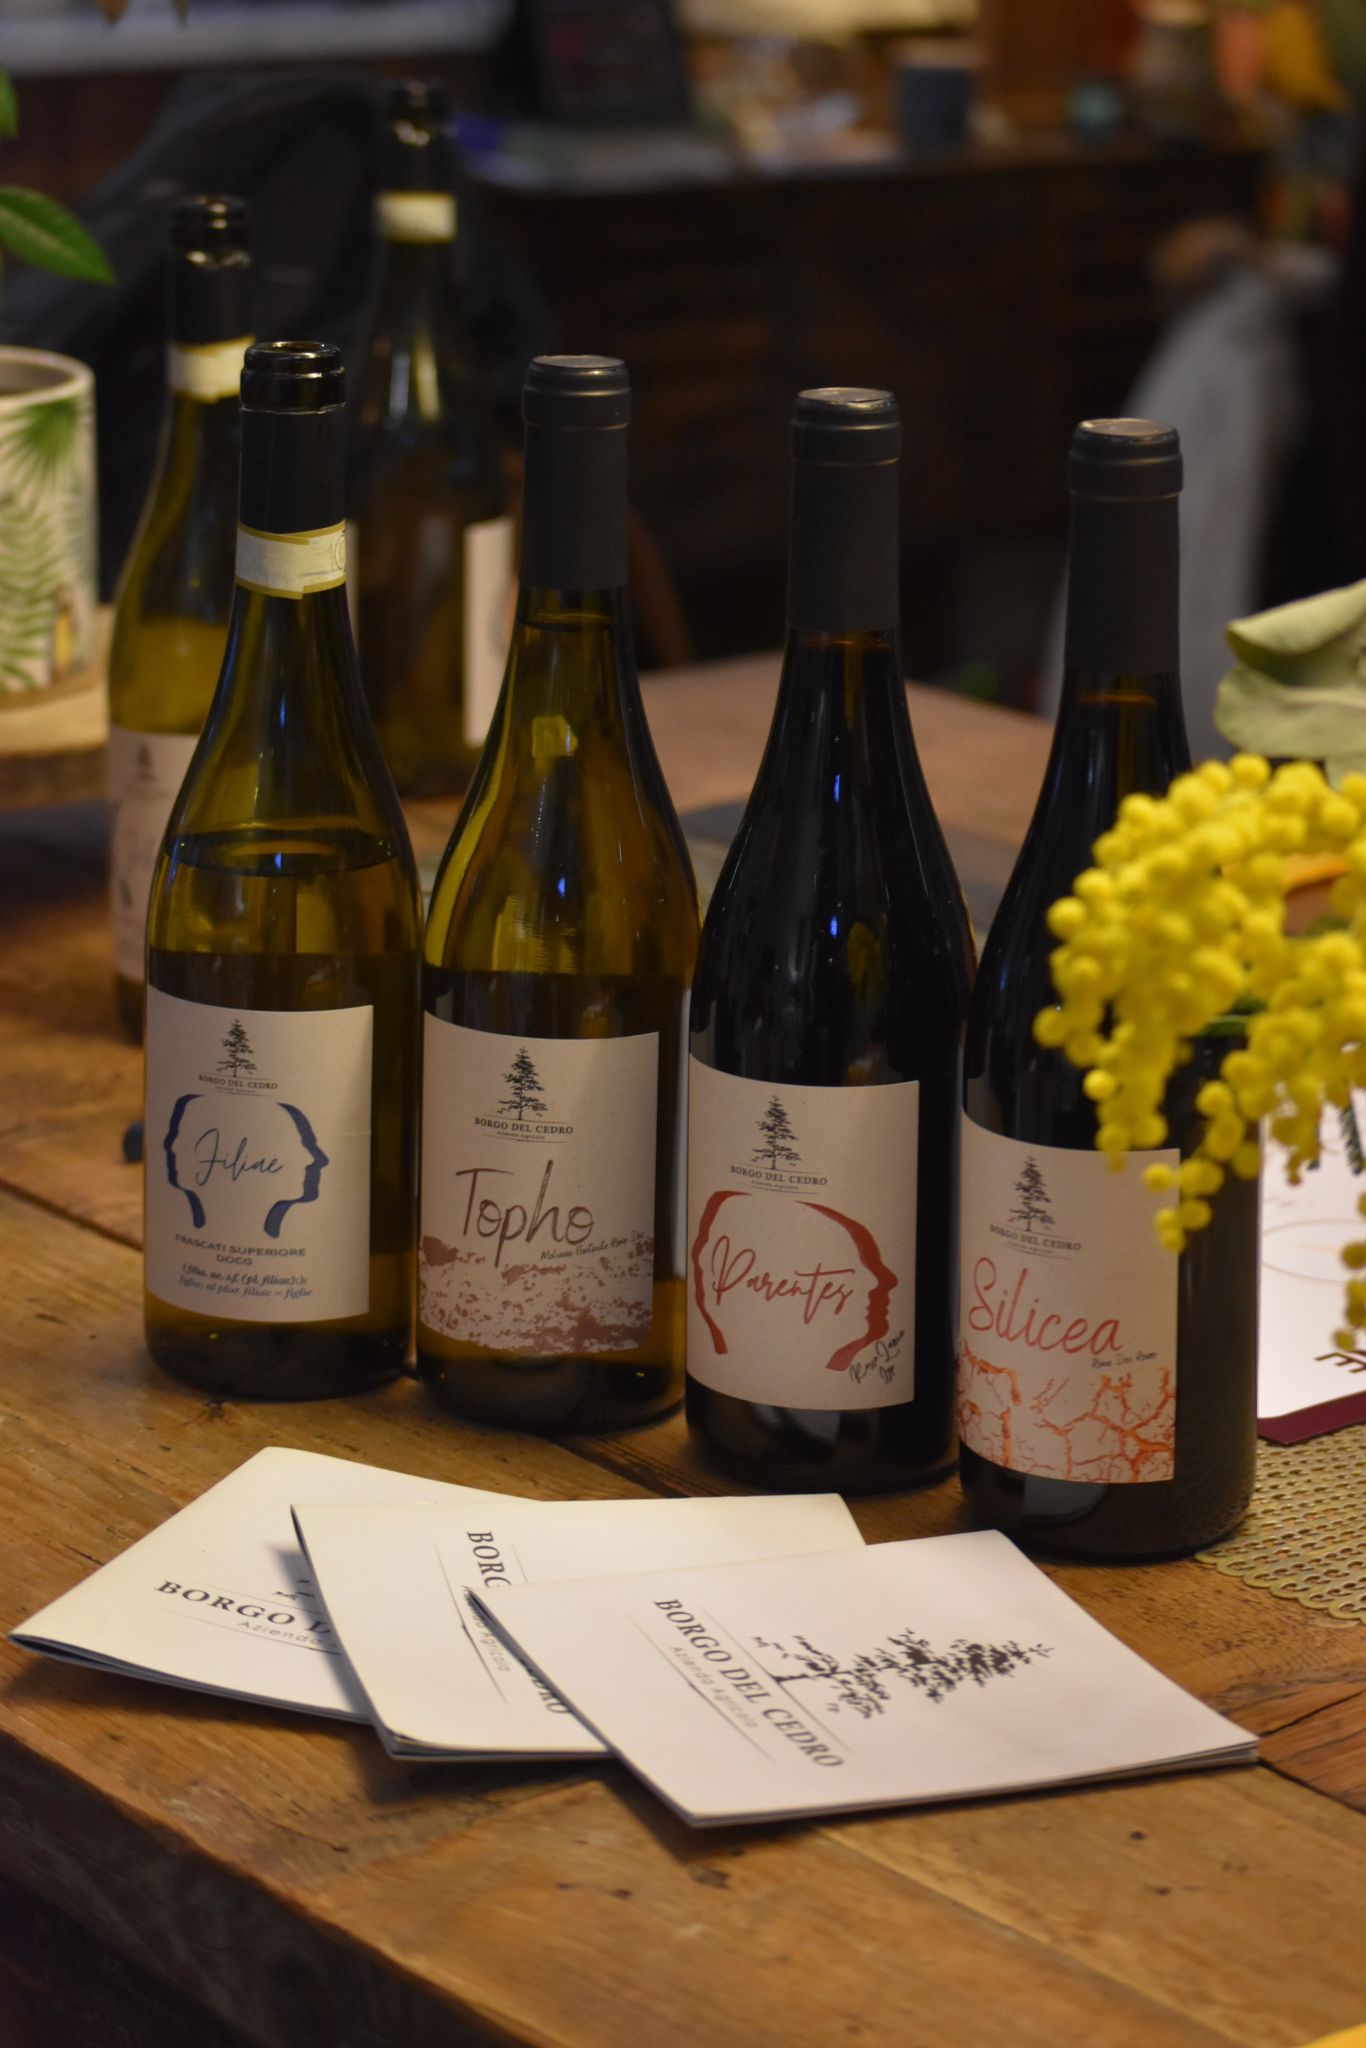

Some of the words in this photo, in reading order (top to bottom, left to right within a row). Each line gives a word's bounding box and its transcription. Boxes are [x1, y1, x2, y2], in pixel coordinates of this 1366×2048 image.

[198, 1074, 226, 1085] BORGO
[228, 1079, 244, 1088] DEL
[247, 1081, 279, 1090] CEDRO
[474, 1116, 508, 1130] BORGO
[511, 1123, 533, 1133] DEL
[535, 1125, 574, 1135] CEDRO
[194, 1128, 285, 1186] Filiae
[730, 1164, 762, 1179] BORGO
[765, 1171, 786, 1183] DEL
[788, 1174, 828, 1186] CEDRO
[456, 1159, 595, 1269] Topho
[175, 1233, 227, 1252] FRASCATI
[230, 1245, 306, 1257] SUPERIORE
[989, 1224, 1018, 1240] BORGO
[1020, 1232, 1041, 1245] DEL
[1043, 1238, 1083, 1251] CEDRO
[216, 1254, 253, 1265] DOCG
[711, 1235, 856, 1324] Parentes
[968, 1257, 1124, 1355] Silicea
[154, 1580, 295, 1625] BORGO
[240, 1620, 324, 1645] Azienda
[654, 1599, 733, 1663] BORGO
[719, 1667, 772, 1703] DEL
[762, 1708, 845, 1767] CEDRO
